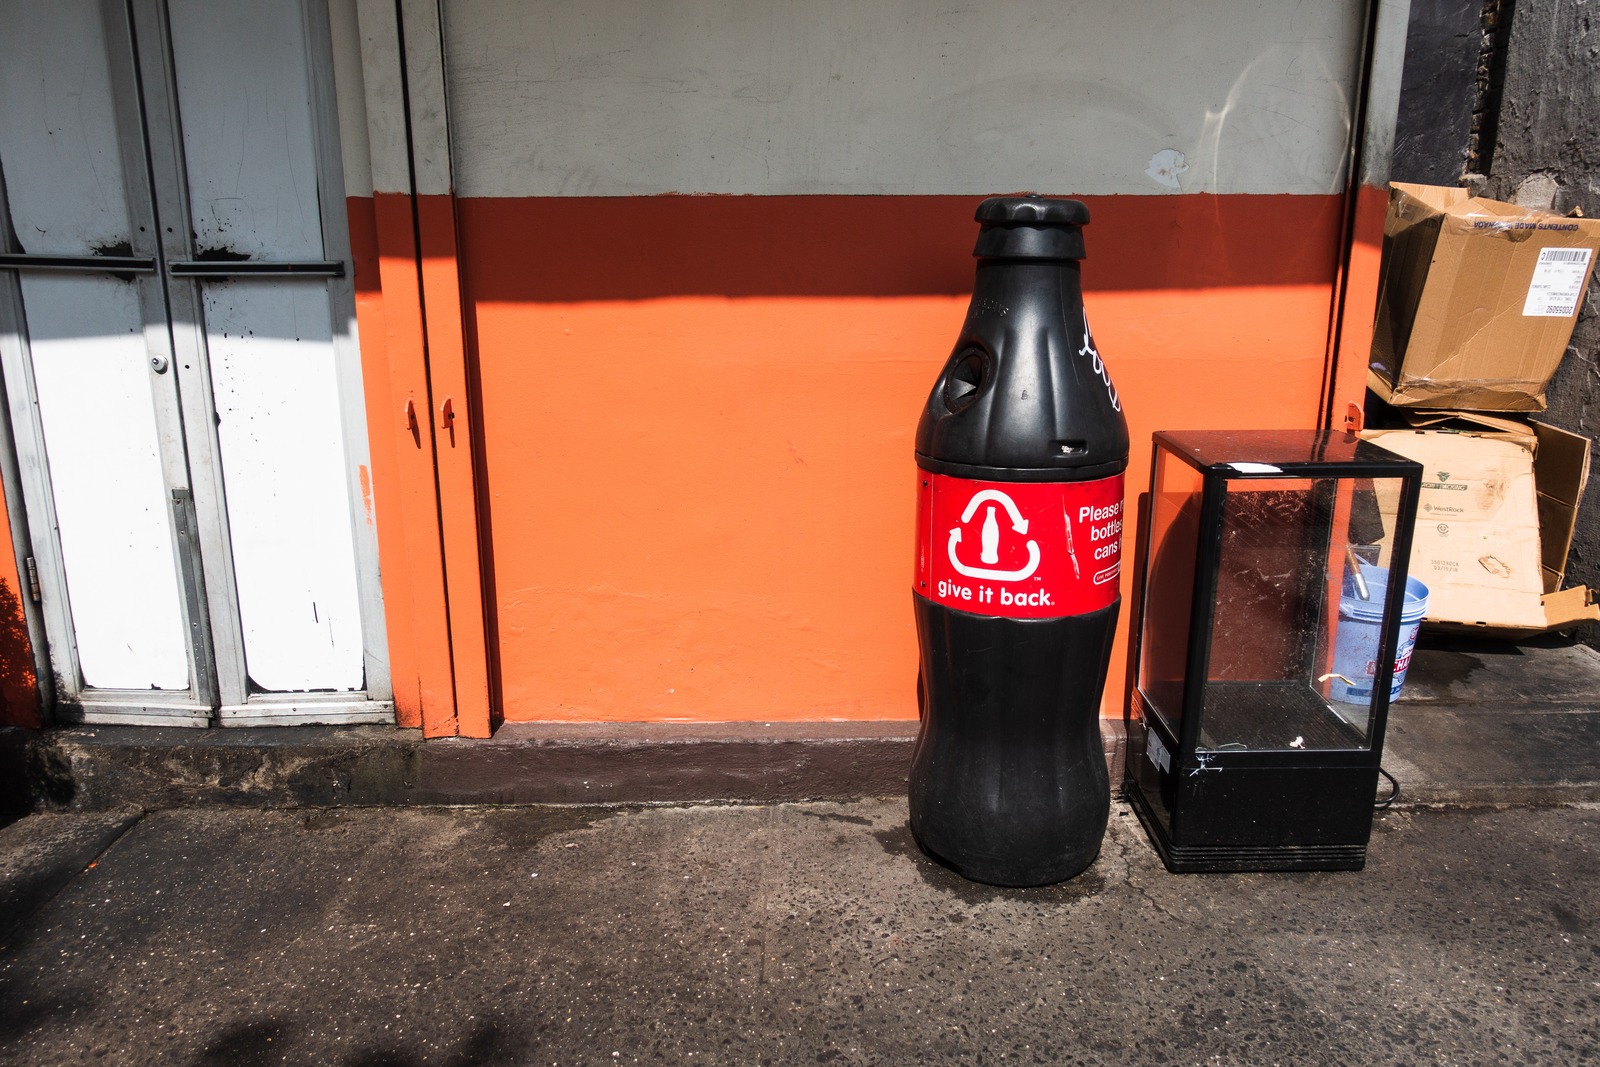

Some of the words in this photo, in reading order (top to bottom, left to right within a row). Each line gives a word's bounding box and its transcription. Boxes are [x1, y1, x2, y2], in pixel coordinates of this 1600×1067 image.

[1514, 222, 1537, 230] MADE
[1538, 223, 1579, 232] CONTENTS
[1079, 502, 1119, 523] Please
[1433, 505, 1464, 513] WestRock
[1094, 541, 1118, 560] cans
[938, 579, 972, 600] give
[979, 585, 994, 604] it
